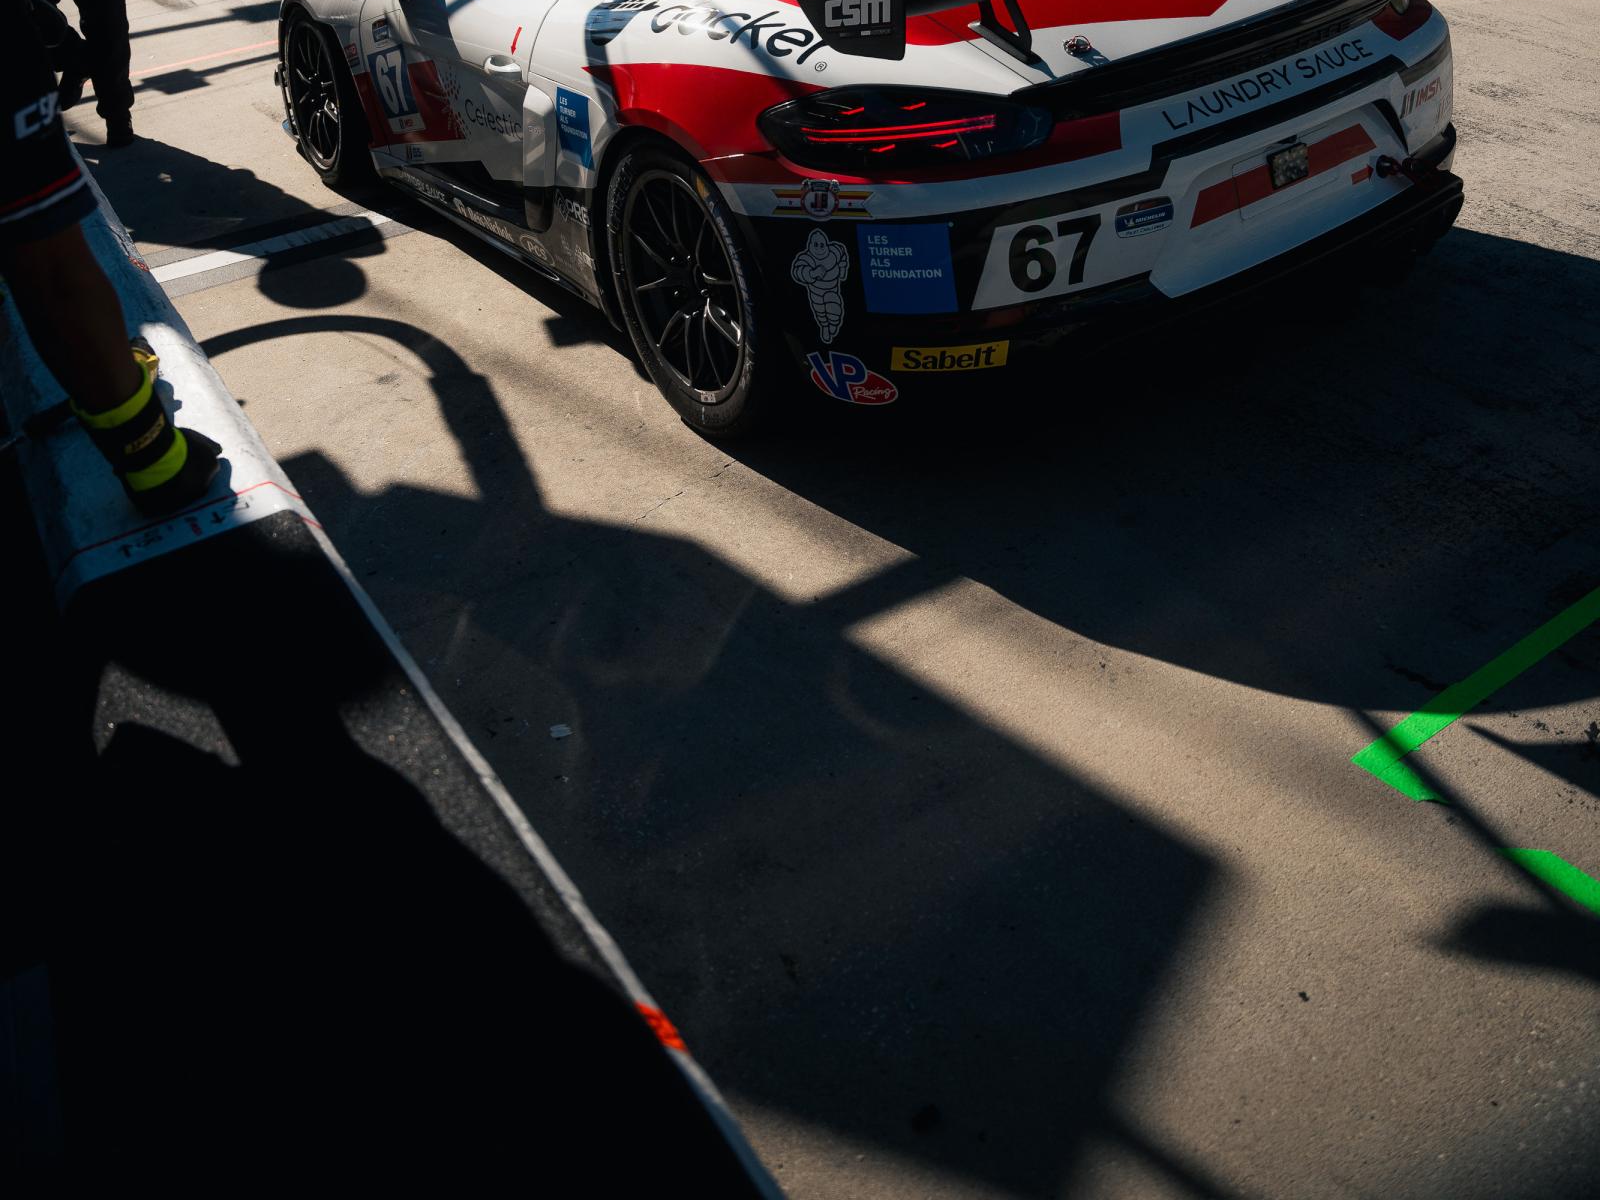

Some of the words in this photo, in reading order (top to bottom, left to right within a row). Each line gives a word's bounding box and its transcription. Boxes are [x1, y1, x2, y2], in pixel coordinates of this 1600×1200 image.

[374, 49, 409, 116] 67
[1161, 64, 1293, 131] LAUNDRY
[1295, 39, 1374, 79] SAUCE
[867, 234, 889, 245] LES
[868, 246, 913, 257] TURNER
[1008, 213, 1102, 293] 67
[870, 257, 891, 268] ALS
[871, 268, 943, 279] FOUNDATION
[902, 345, 998, 370] Sabelt
[806, 350, 868, 401] VP
[853, 386, 895, 400] Racing
